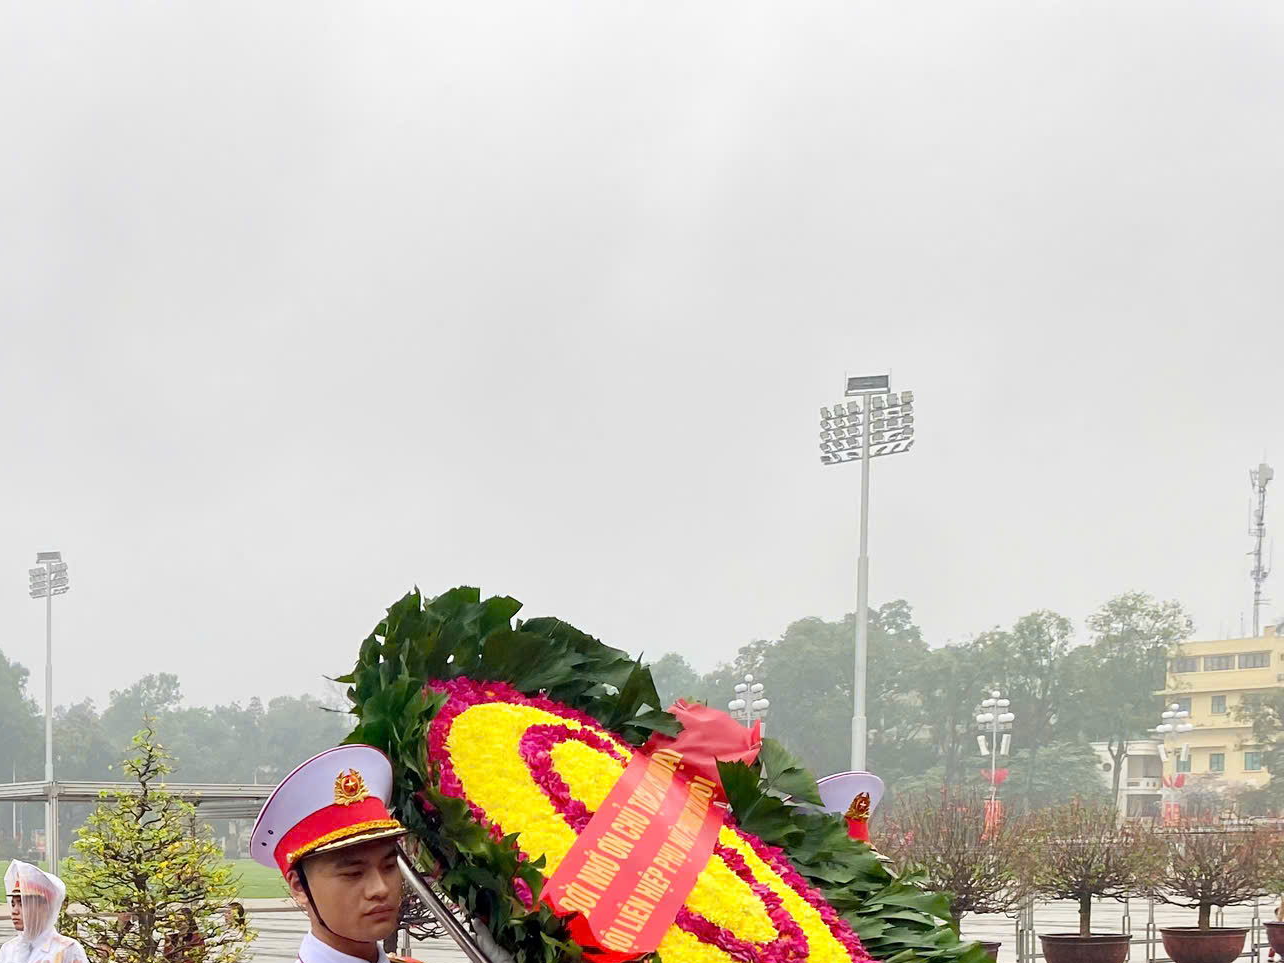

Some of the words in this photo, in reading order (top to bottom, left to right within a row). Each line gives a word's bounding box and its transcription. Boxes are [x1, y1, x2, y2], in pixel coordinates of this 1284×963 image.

[611, 802, 650, 840] CHỦ
[597, 831, 635, 859] ƠN
[653, 841, 692, 874] PHỤ
[576, 849, 621, 891] NHỚ
[634, 866, 674, 903] HIỆP
[615, 895, 655, 933] LIÊN
